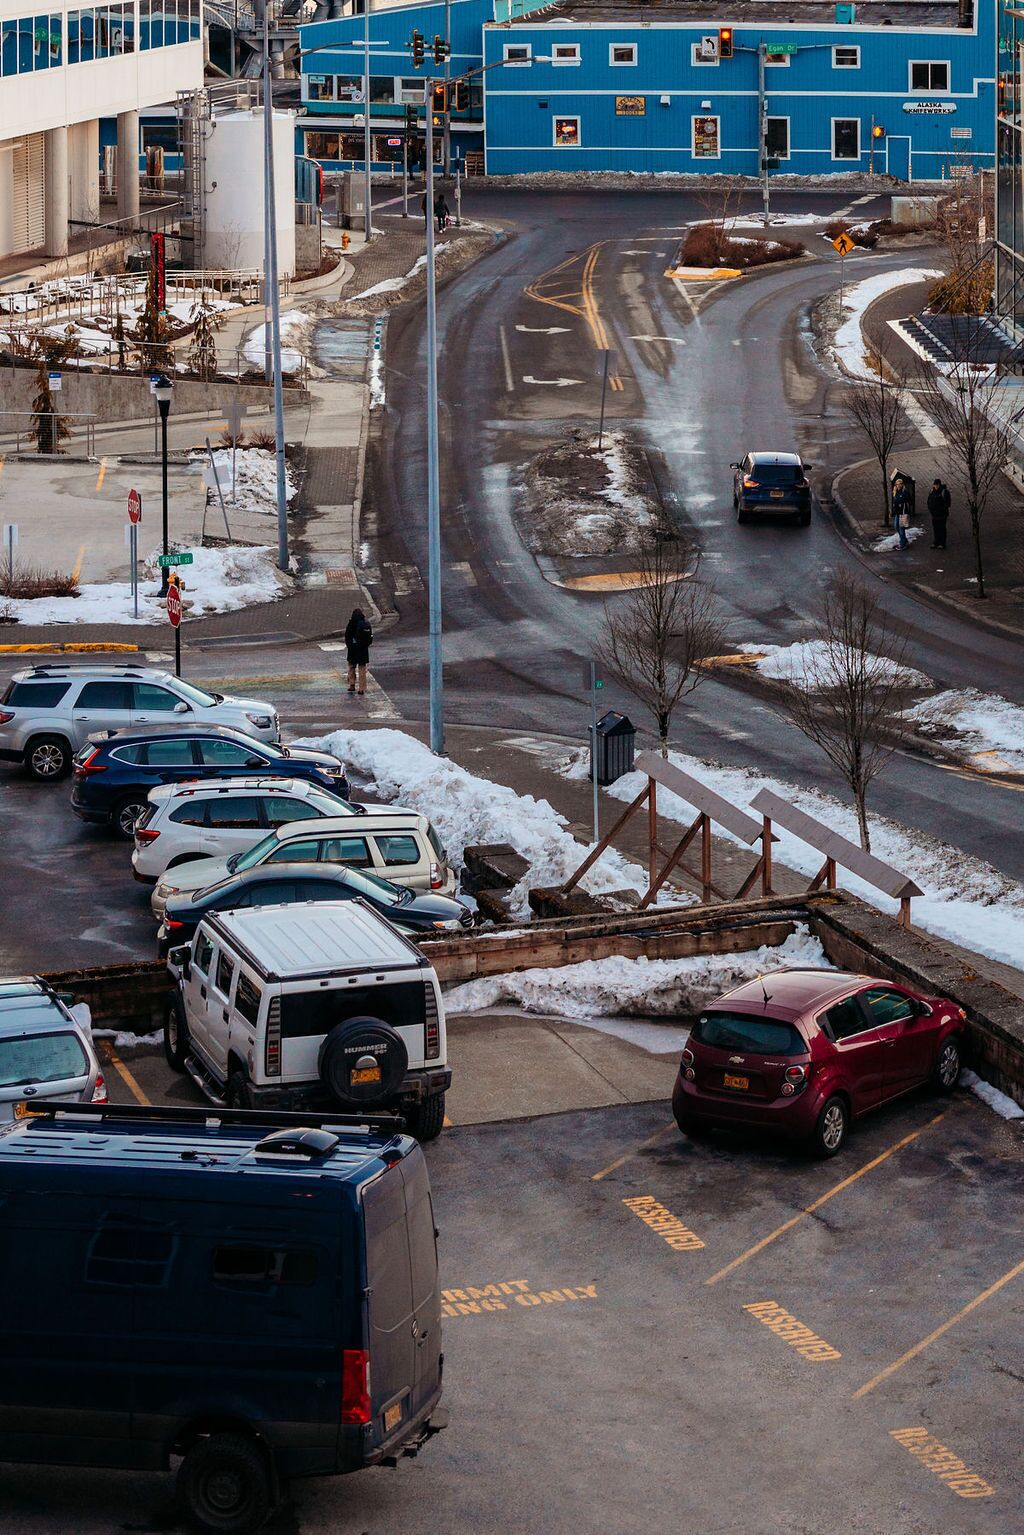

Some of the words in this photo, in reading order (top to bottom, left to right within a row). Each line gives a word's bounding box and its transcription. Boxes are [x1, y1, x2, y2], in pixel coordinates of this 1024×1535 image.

[128, 499, 139, 512] STOP
[162, 554, 182, 565] FRONT
[168, 597, 181, 615] STOP
[344, 1044, 387, 1054] HUMMER
[622, 1195, 706, 1252] RESERVED
[441, 1280, 530, 1302] RMIT
[441, 1299, 509, 1317] ING
[515, 1285, 598, 1306] ONLY
[742, 1301, 843, 1362] RESERVED
[888, 1427, 996, 1499] RESERVED
